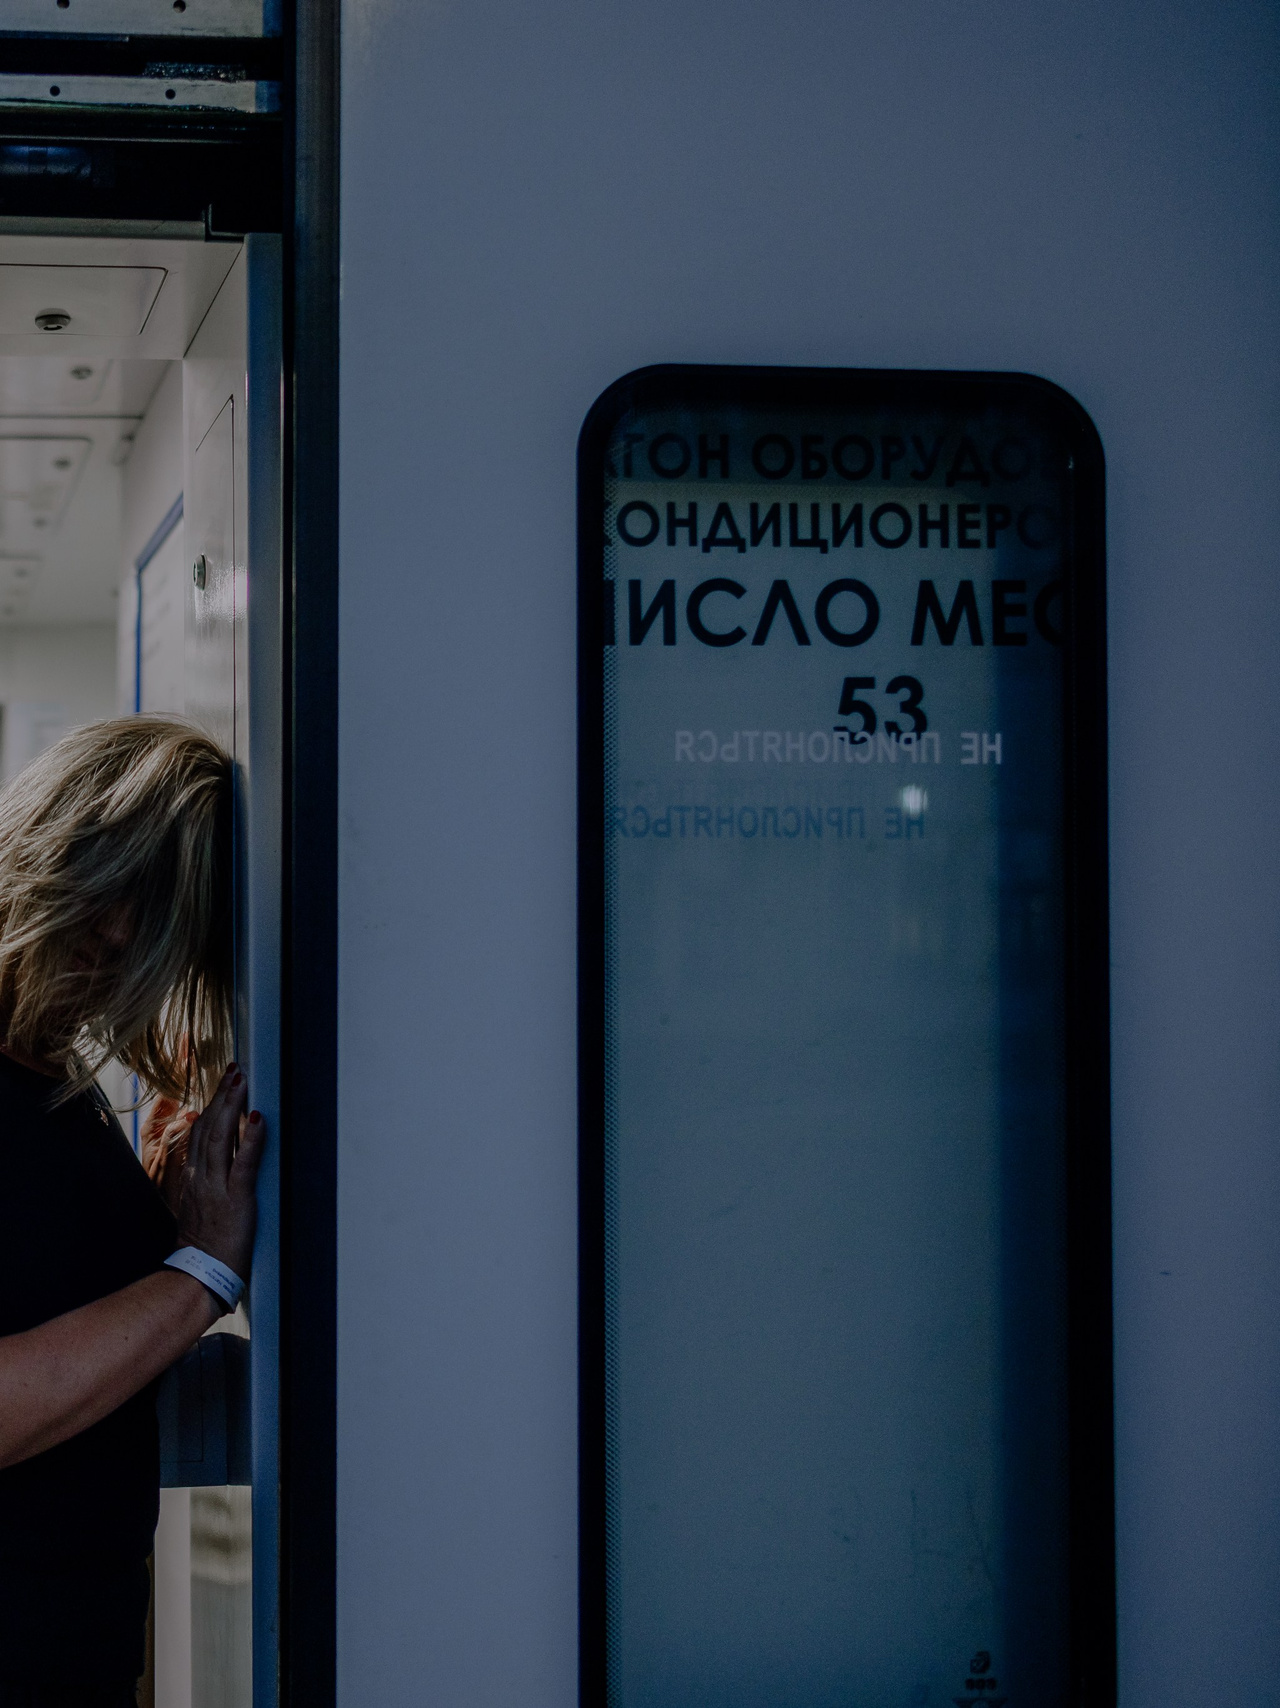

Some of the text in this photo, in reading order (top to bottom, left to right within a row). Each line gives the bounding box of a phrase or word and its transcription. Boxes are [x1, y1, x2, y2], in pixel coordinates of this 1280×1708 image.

[606, 433, 1059, 488] ГОН ОБОРУДО
[606, 501, 1060, 553] ОНДИЦИОНЕРО
[604, 578, 880, 647] ИСЛО
[833, 675, 928, 745] 53
